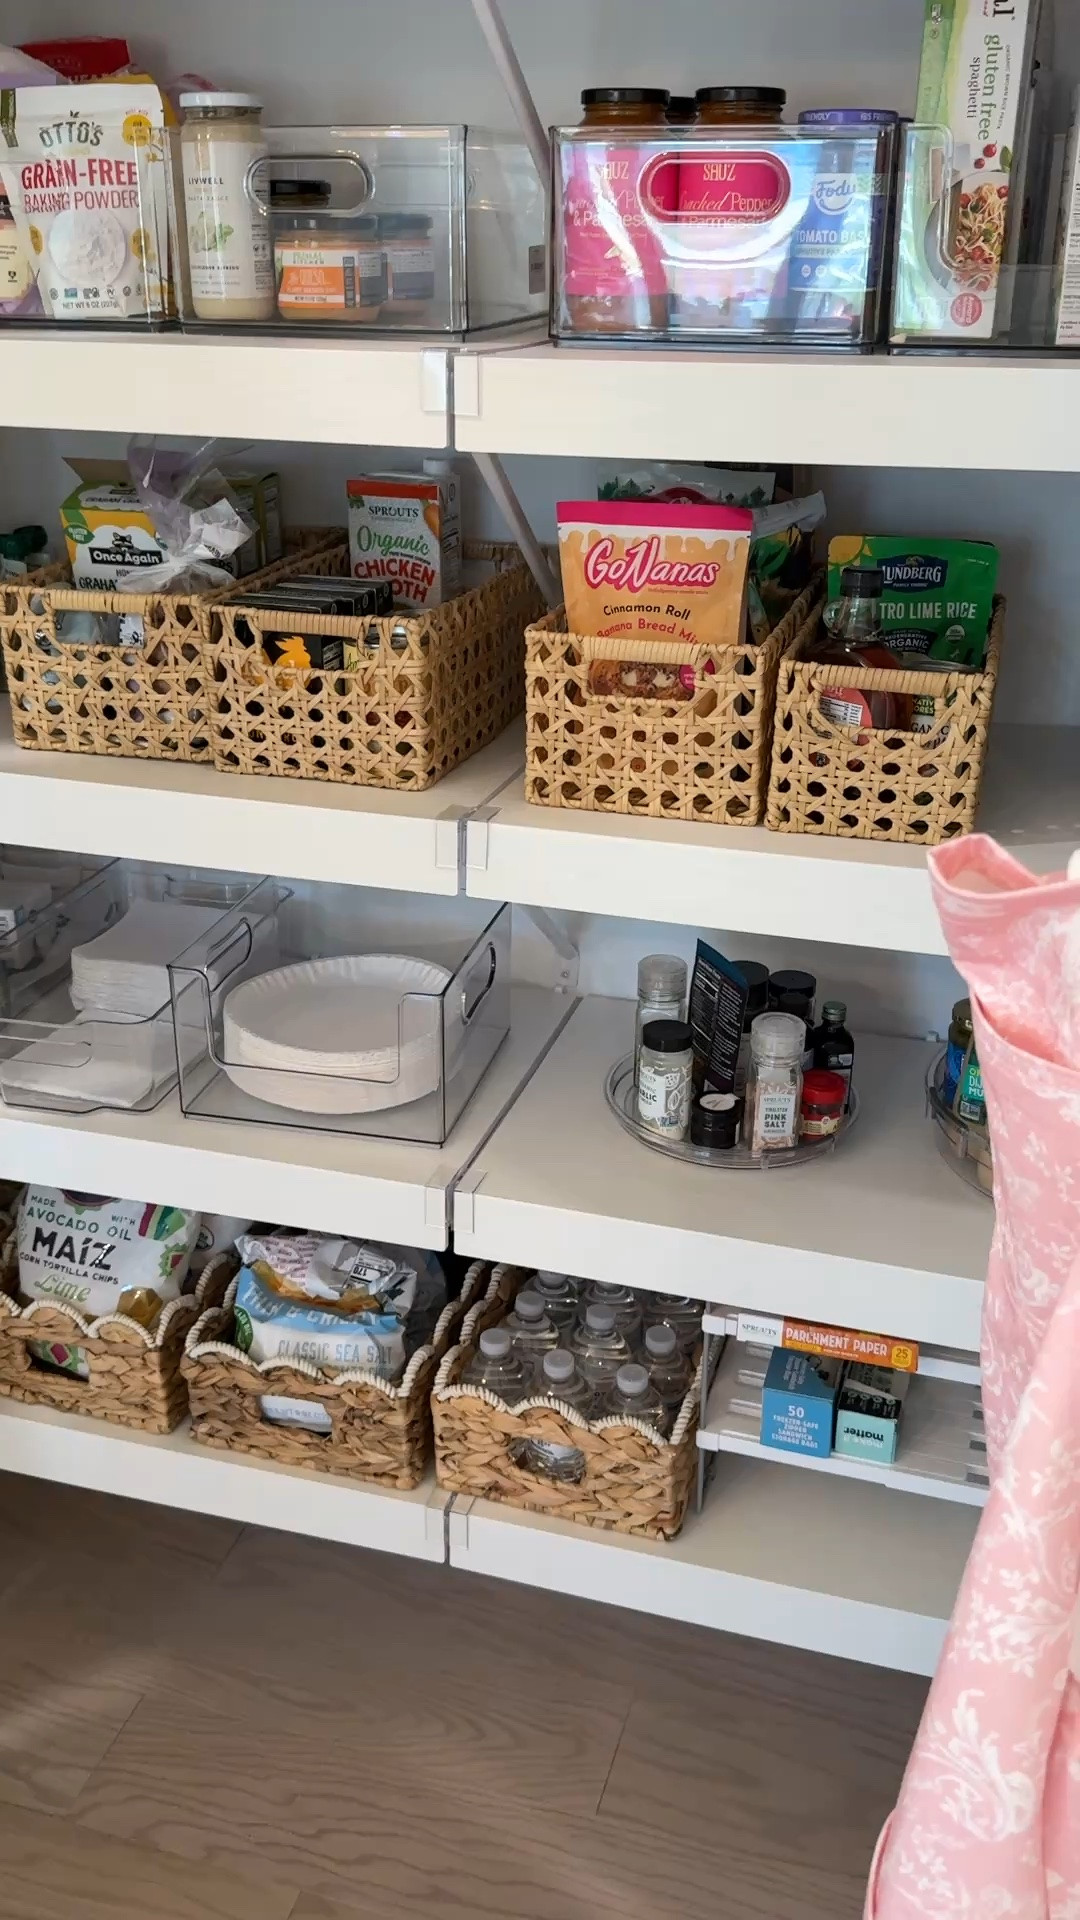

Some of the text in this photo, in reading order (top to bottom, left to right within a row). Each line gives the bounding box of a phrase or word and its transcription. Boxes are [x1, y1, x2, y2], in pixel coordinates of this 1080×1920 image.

[966, 56, 981, 119] spaghetti
[977, 34, 1004, 141] gluten free
[21, 158, 139, 191] GRAIN-FREE
[24, 189, 140, 214] BAKING POWDER
[840, 230, 867, 243] BAS
[367, 505, 420, 518] SPROUTS
[356, 525, 431, 557] Organic
[93, 550, 160, 565] Once Again
[585, 535, 720, 592] GoNanas
[354, 558, 437, 587] CHICKEN
[78, 577, 118, 591] GRAHA
[603, 604, 691, 621] Cinnamon Roll
[909, 602, 942, 619] LIME
[947, 602, 978, 619] RICE
[596, 622, 633, 638] Banana
[638, 618, 676, 635] Bread
[764, 1113, 787, 1121] PINK
[764, 1120, 787, 1128] SALT
[31, 1194, 58, 1208] MADE
[27, 1206, 132, 1241] AVOCADO OIL
[19, 1251, 120, 1285] CORN TORTILLA CHIPS
[353, 1265, 367, 1277] 170
[33, 1273, 92, 1303] Lime
[278, 1339, 393, 1365] CLASSIC SEA SALT
[785, 1327, 850, 1351] PARCHMENT
[853, 1339, 888, 1357] PAPER
[895, 1347, 909, 1359] 25
[787, 1404, 805, 1418] 50
